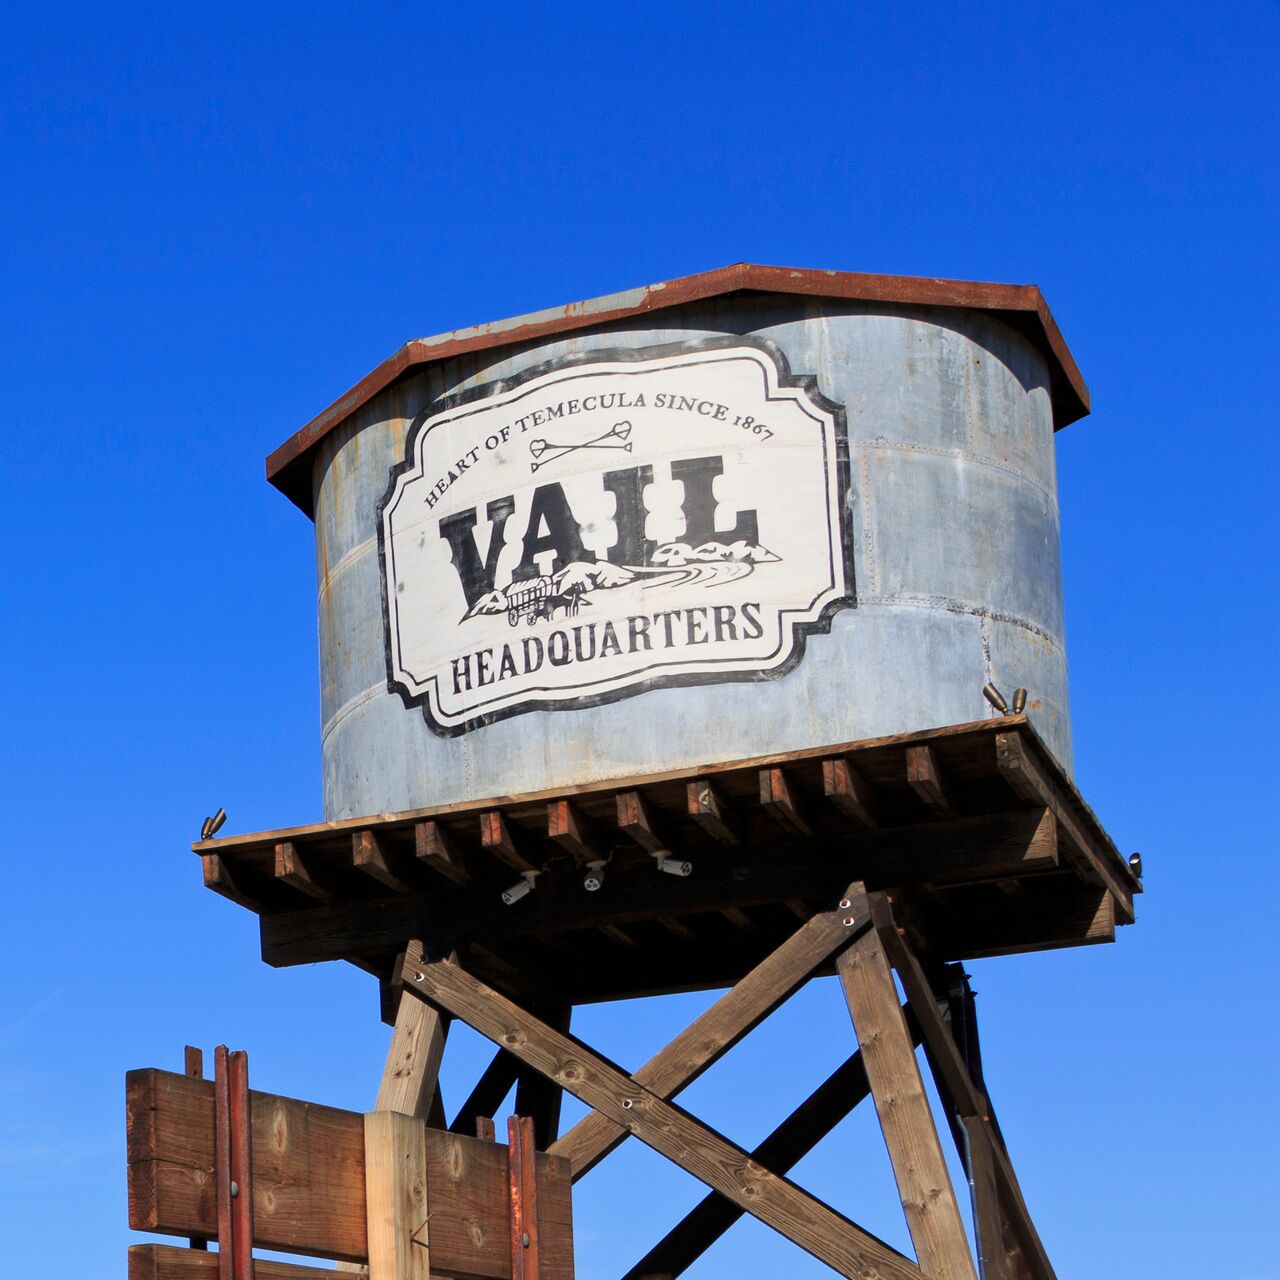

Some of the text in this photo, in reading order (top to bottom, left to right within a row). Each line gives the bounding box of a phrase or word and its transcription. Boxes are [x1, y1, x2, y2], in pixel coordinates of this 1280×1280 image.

[423, 392, 776, 510] HEART OF TEMECULA SINCE 1867
[438, 455, 760, 609] VAIL
[450, 602, 765, 696] HEADQUARTERS
